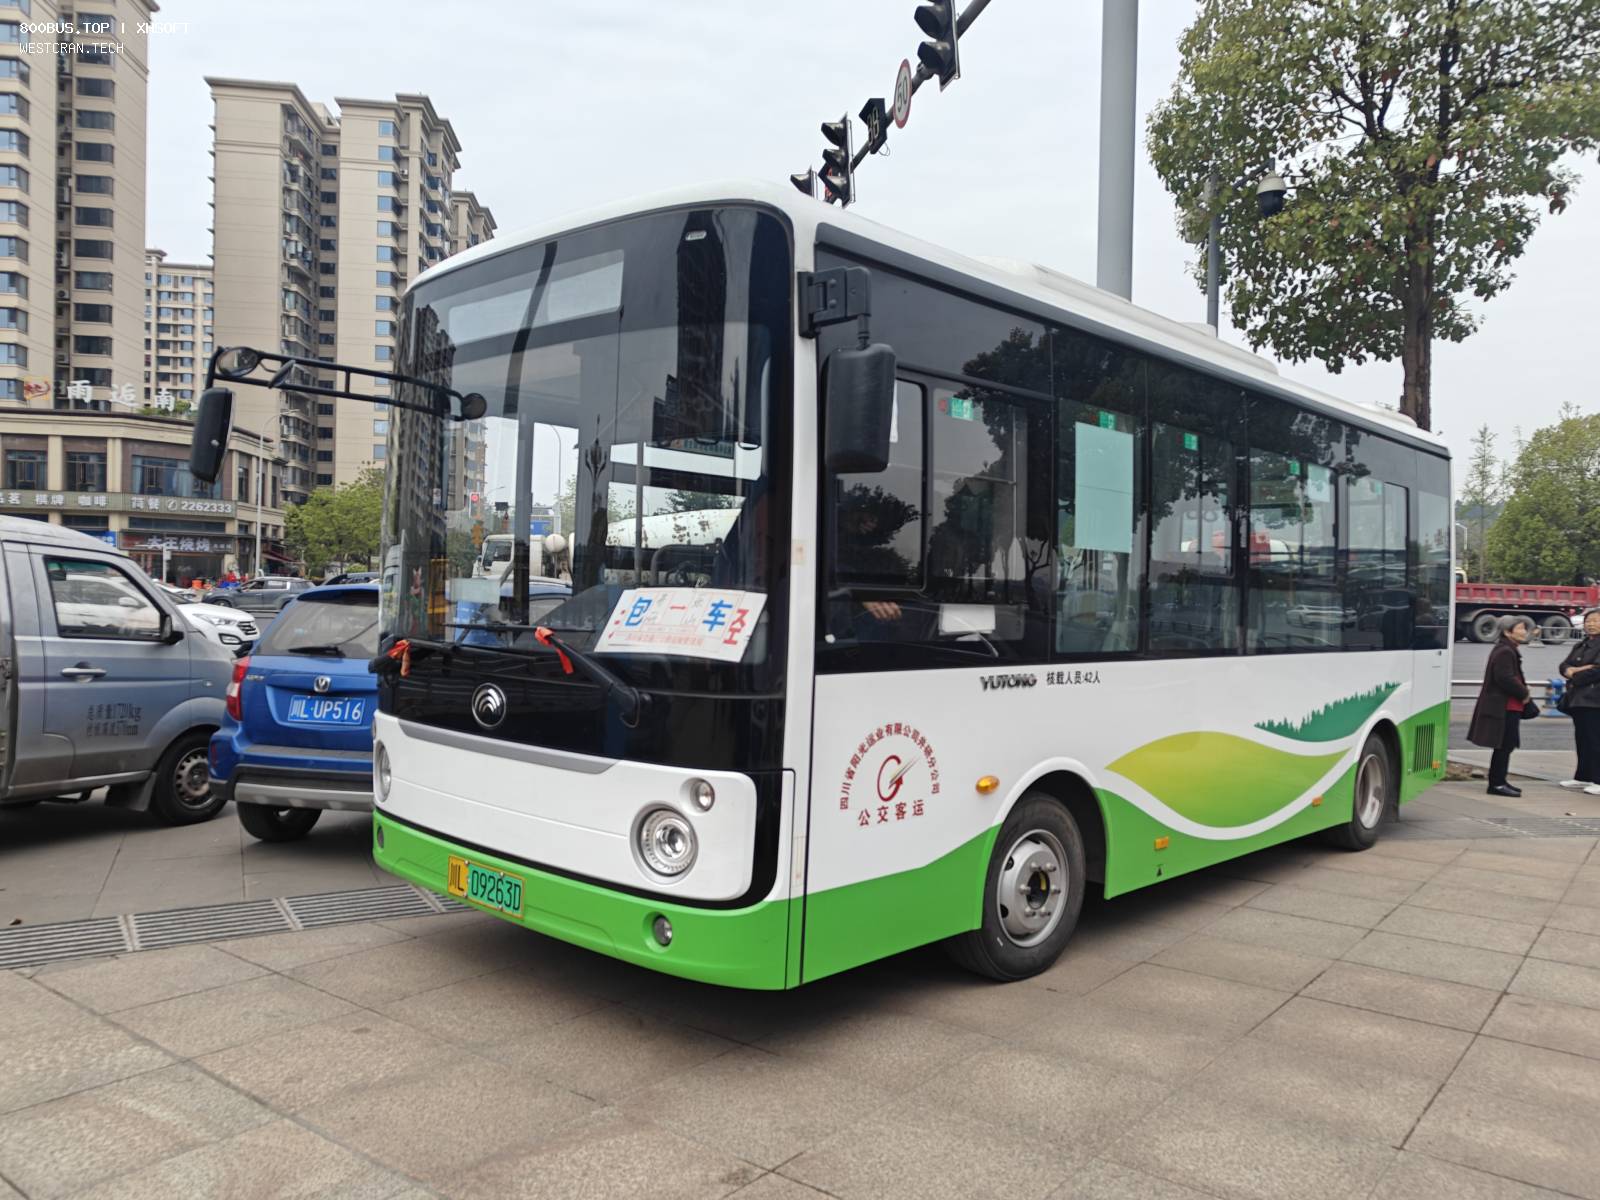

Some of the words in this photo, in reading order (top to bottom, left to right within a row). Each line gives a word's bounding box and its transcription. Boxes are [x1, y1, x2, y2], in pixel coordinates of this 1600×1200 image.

[181, 501, 232, 513] 2262333
[980, 673, 1037, 691] YUTONG
[858, 799, 924, 826] 公交客运
[449, 862, 522, 911] 川L09263D
